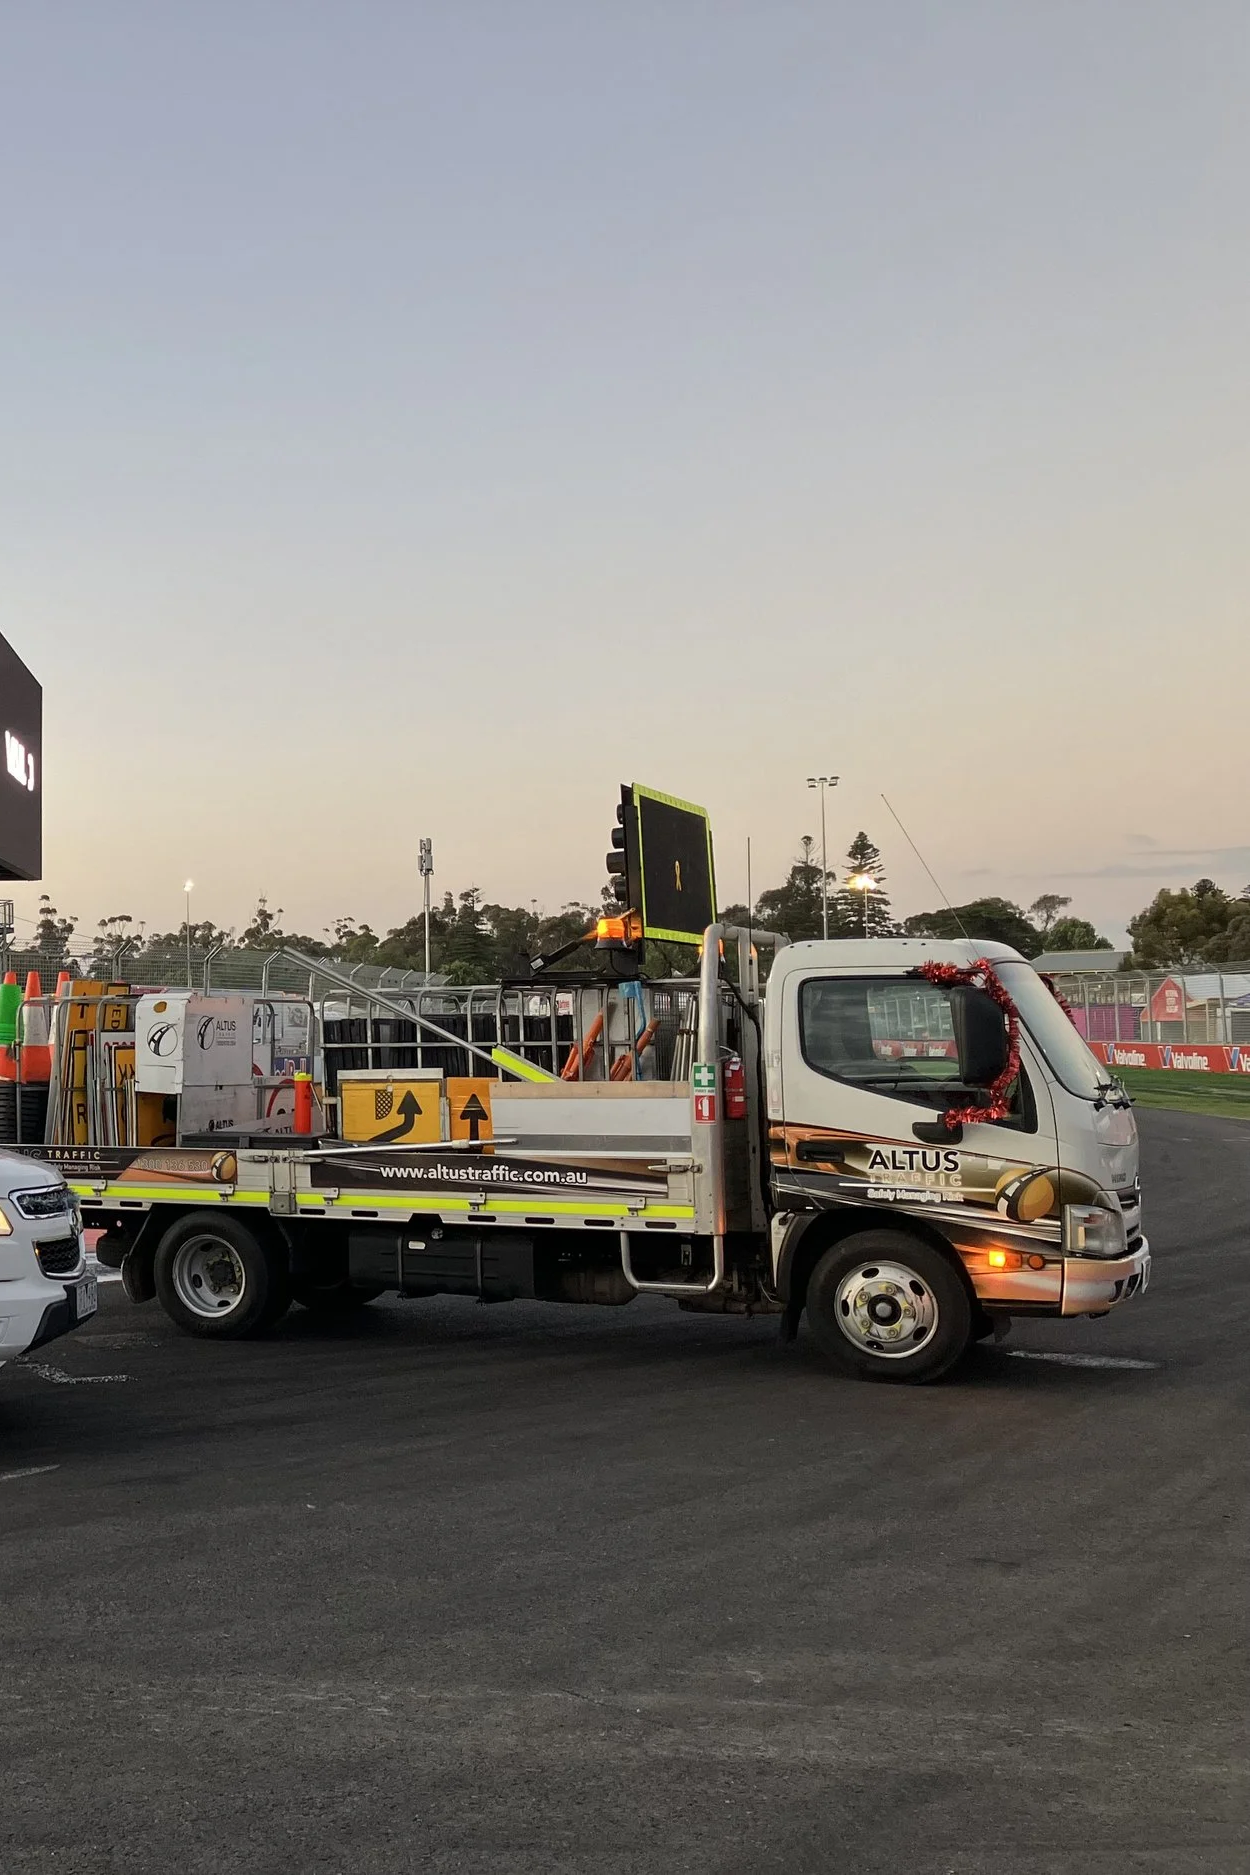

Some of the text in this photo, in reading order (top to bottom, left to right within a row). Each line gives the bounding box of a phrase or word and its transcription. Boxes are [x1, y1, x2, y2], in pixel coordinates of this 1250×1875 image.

[216, 1020, 236, 1032] ALTUS
[47, 1150, 101, 1160] TRAFFIC
[868, 1149, 960, 1172] ALTUS
[380, 1163, 587, 1184] www.altustraffic.com.au
[869, 1172, 962, 1187] TRAFFIC
